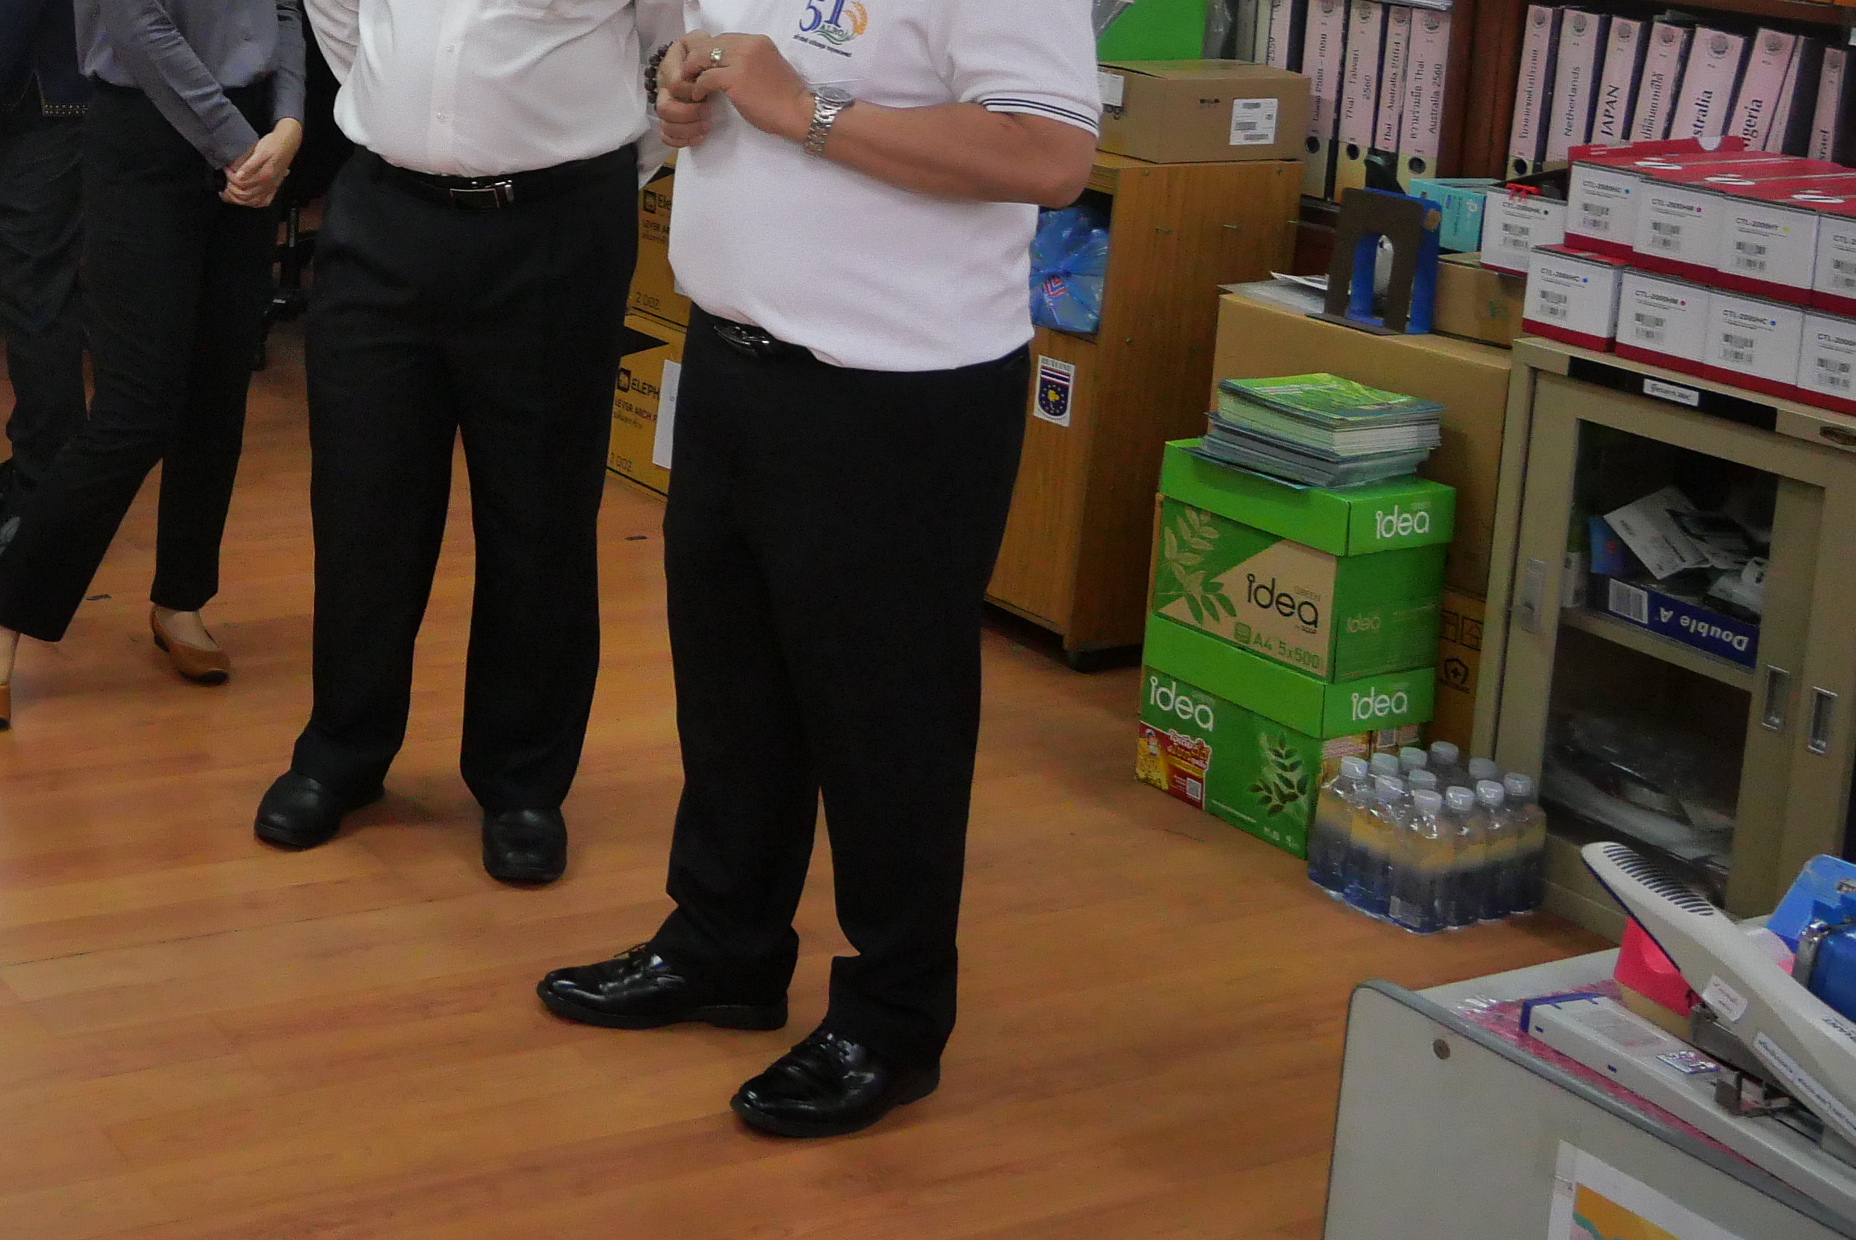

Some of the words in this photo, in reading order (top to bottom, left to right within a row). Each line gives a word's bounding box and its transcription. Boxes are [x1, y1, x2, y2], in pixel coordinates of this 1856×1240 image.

[1429, 91, 1441, 135] Australia
[1564, 66, 1581, 137] Netherlands
[1601, 84, 1621, 137] JAPAN
[1692, 90, 1713, 137] stralia
[1819, 129, 1830, 160] srael
[631, 378, 660, 400] ELEPH
[1375, 504, 1430, 539] idea
[1246, 573, 1319, 629] idea
[1658, 607, 1674, 623] A
[1252, 632, 1273, 651] A4
[1679, 615, 1750, 652] Double
[1149, 676, 1215, 732] idea
[1351, 686, 1408, 721] idea
